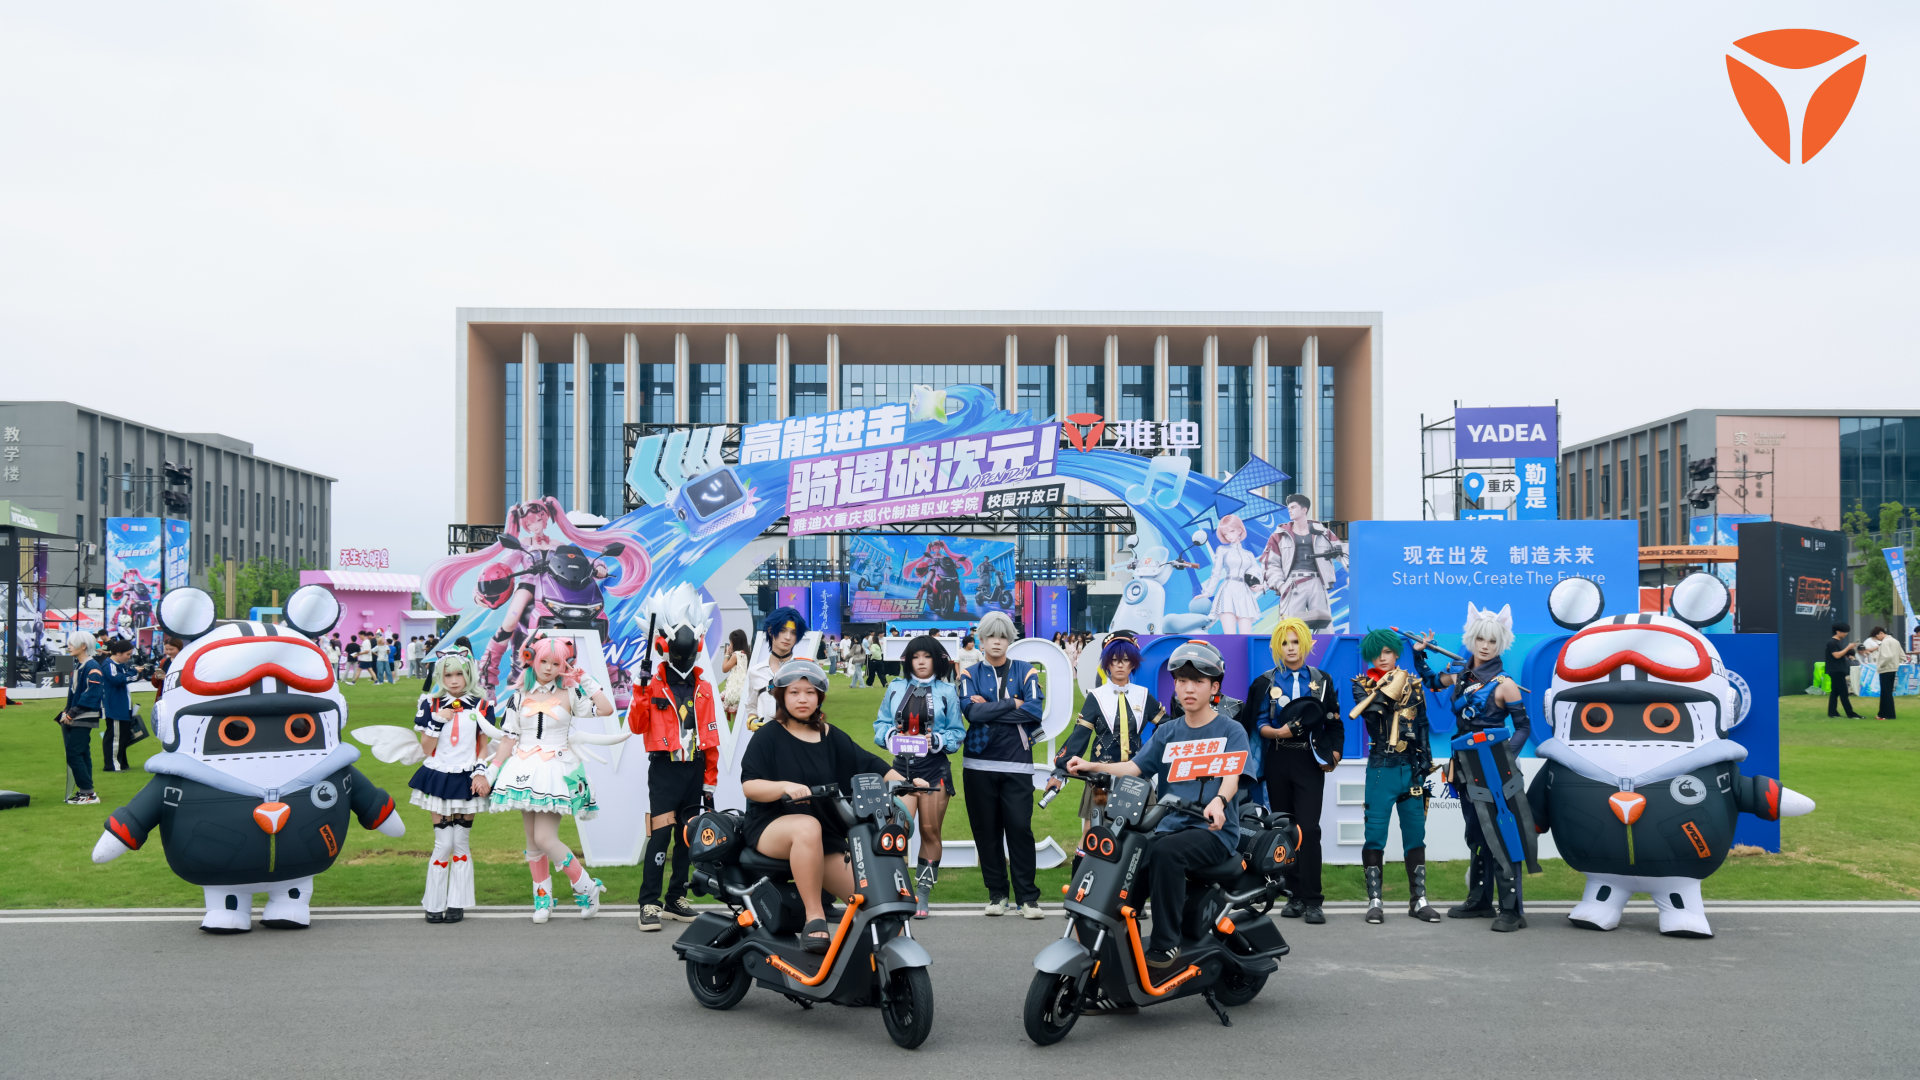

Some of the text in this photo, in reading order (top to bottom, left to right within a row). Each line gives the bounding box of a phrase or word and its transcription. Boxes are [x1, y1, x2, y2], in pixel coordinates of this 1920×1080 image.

[741, 405, 907, 466] 高能进击
[1113, 418, 1201, 450] 雅迪
[1466, 423, 1547, 443] YADEA
[4, 426, 20, 481] 教学楼
[790, 425, 1058, 513] 骑遇破次元!
[1004, 462, 1039, 486] DAY
[1487, 479, 1516, 493] 重庆
[1524, 463, 1548, 509] 勒是
[986, 487, 1060, 509] 校园开放日
[792, 496, 980, 532] 雅迪X重庆现代制造职业学院
[340, 548, 389, 569] 天生大明星
[1403, 545, 1595, 566] 现在出发 制造未来
[1392, 571, 1429, 585] Start
[1525, 570, 1553, 585] The
[1558, 570, 1606, 585] Fre
[1168, 740, 1220, 757] 大学生的
[1176, 755, 1241, 778] 第一台车
[858, 776, 881, 787] EZ
[1119, 786, 1141, 797] STUDIO
[1121, 777, 1145, 793] EZ
